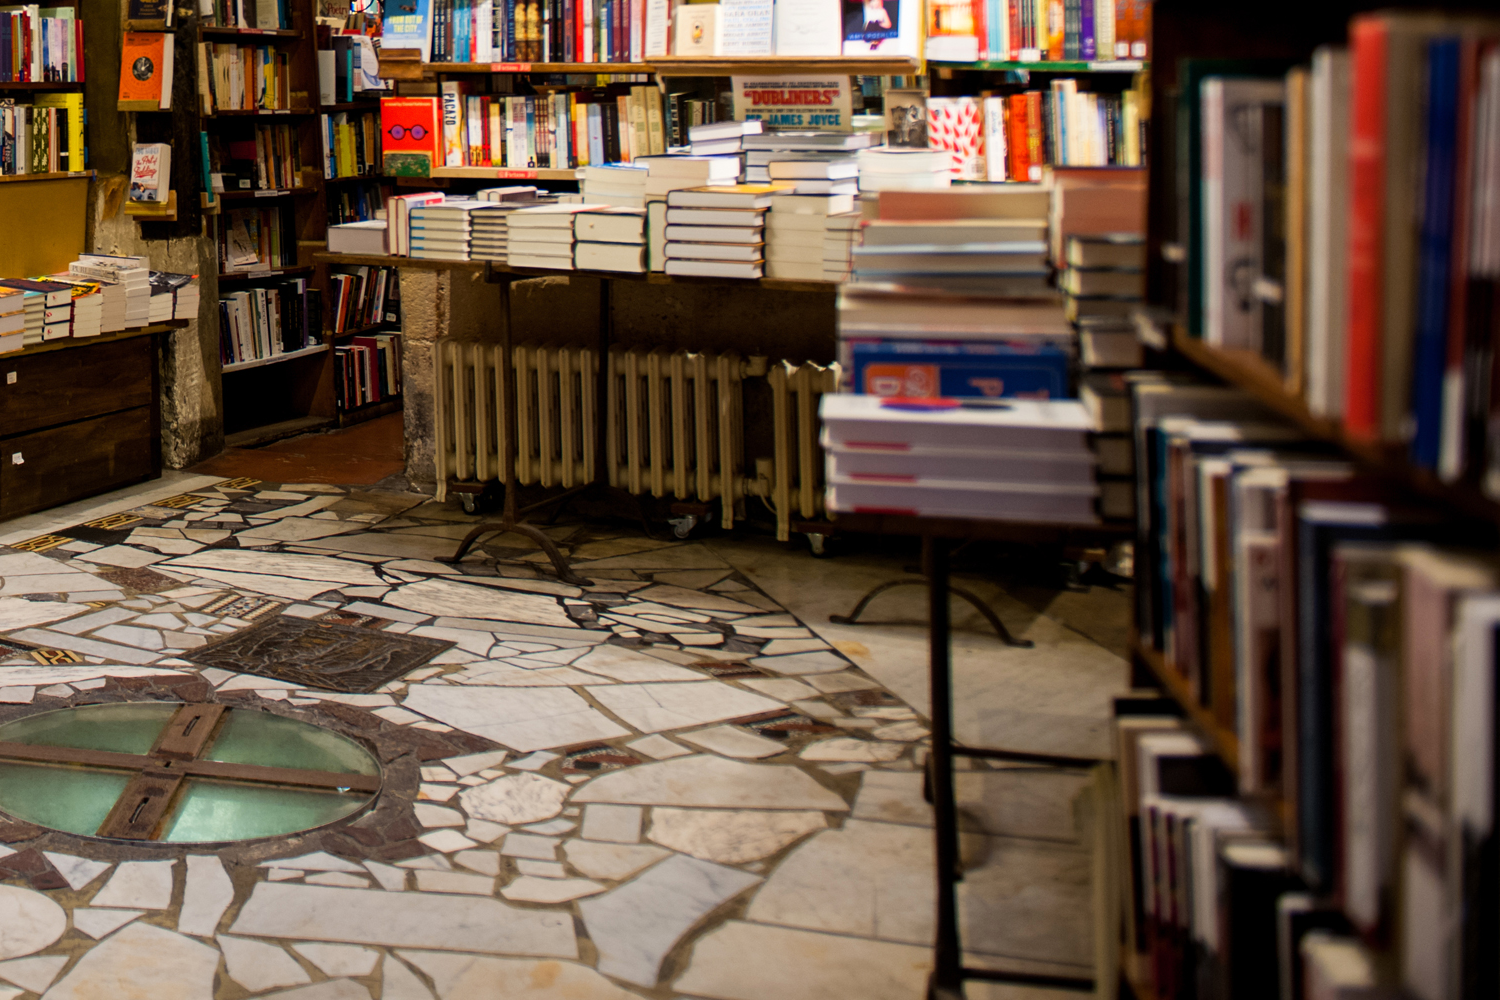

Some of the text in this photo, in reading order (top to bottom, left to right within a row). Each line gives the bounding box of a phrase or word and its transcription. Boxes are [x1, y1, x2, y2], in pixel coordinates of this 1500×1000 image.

[327, 3, 349, 18] Poetry
[388, 15, 404, 25] FROM
[393, 24, 418, 34] THE CITY
[444, 93, 456, 126] PACAZO
[767, 114, 842, 126] JAMES JOYCE
[142, 154, 154, 165] Art
